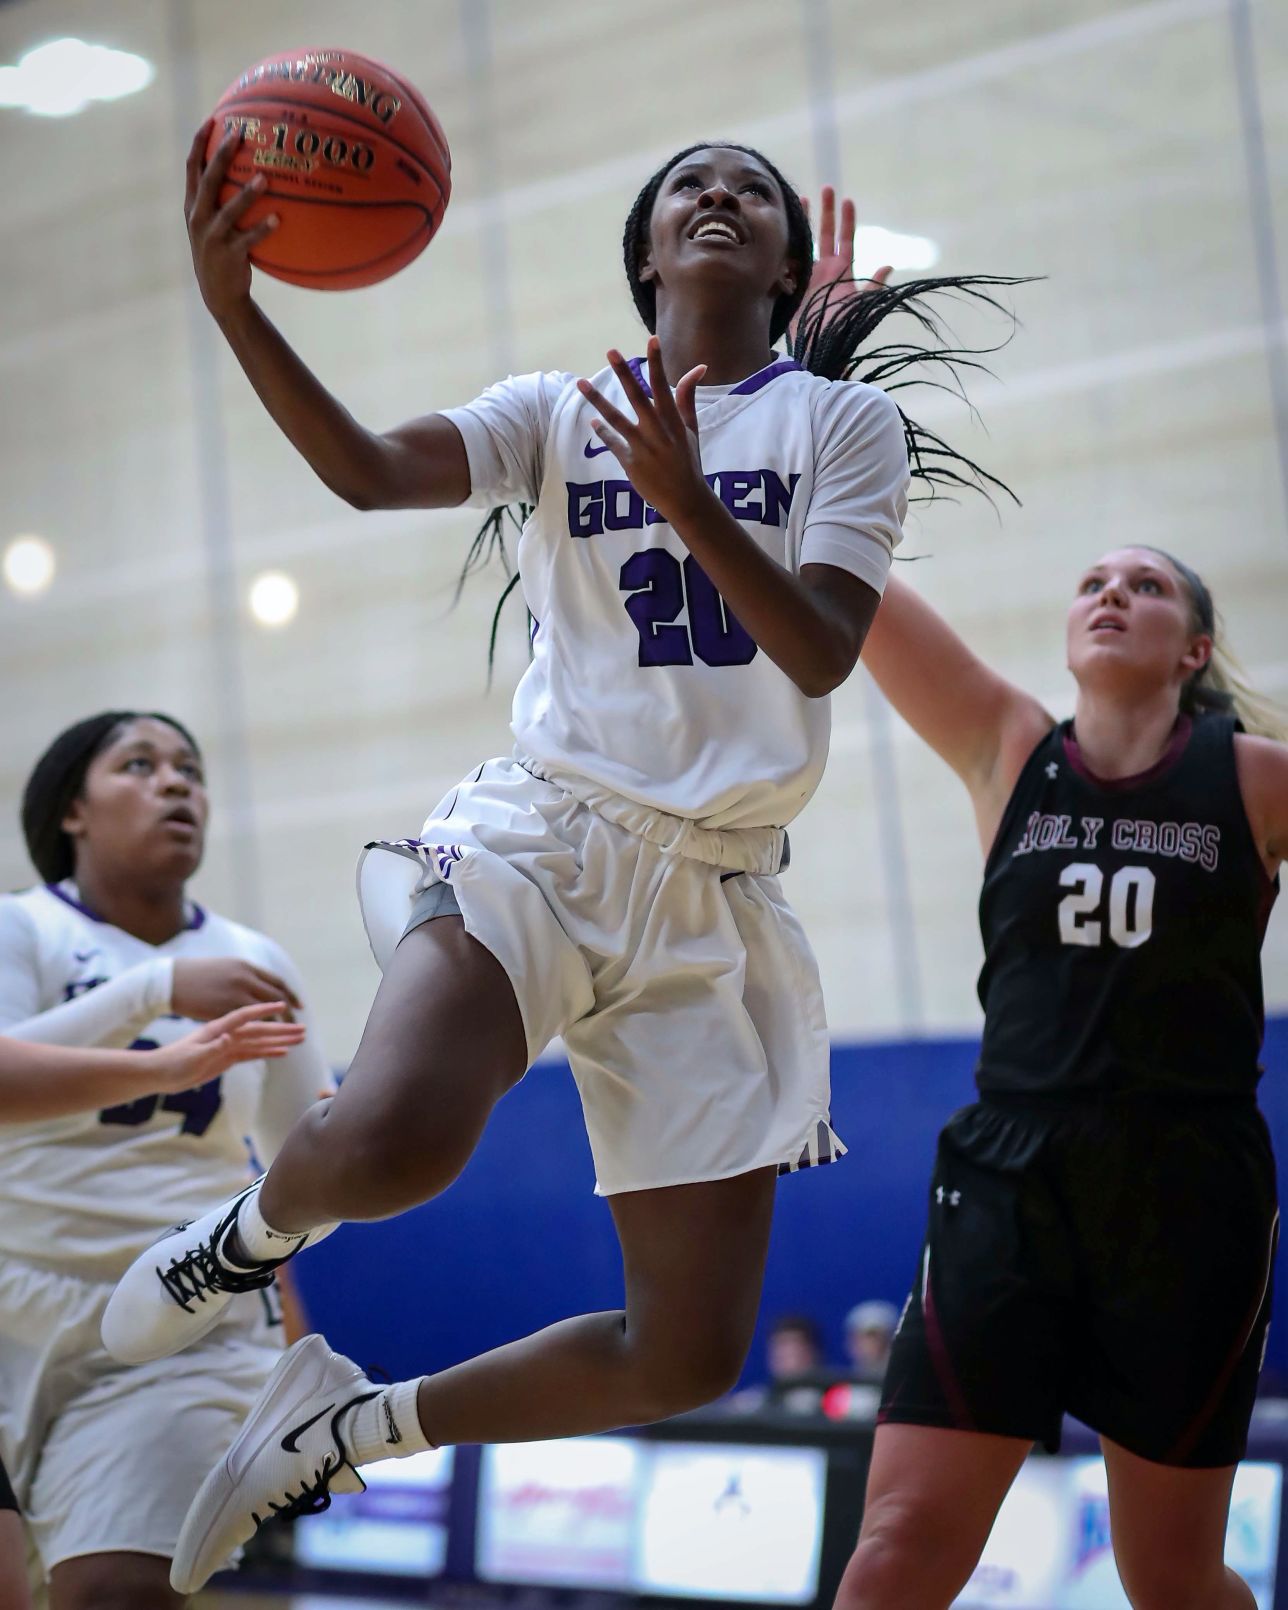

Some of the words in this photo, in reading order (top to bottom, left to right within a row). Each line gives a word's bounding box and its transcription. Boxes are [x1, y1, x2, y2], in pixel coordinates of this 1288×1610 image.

[566, 469, 801, 538] GOEN
[1111, 818, 1221, 872] CROSS
[1057, 862, 1156, 948] 20
